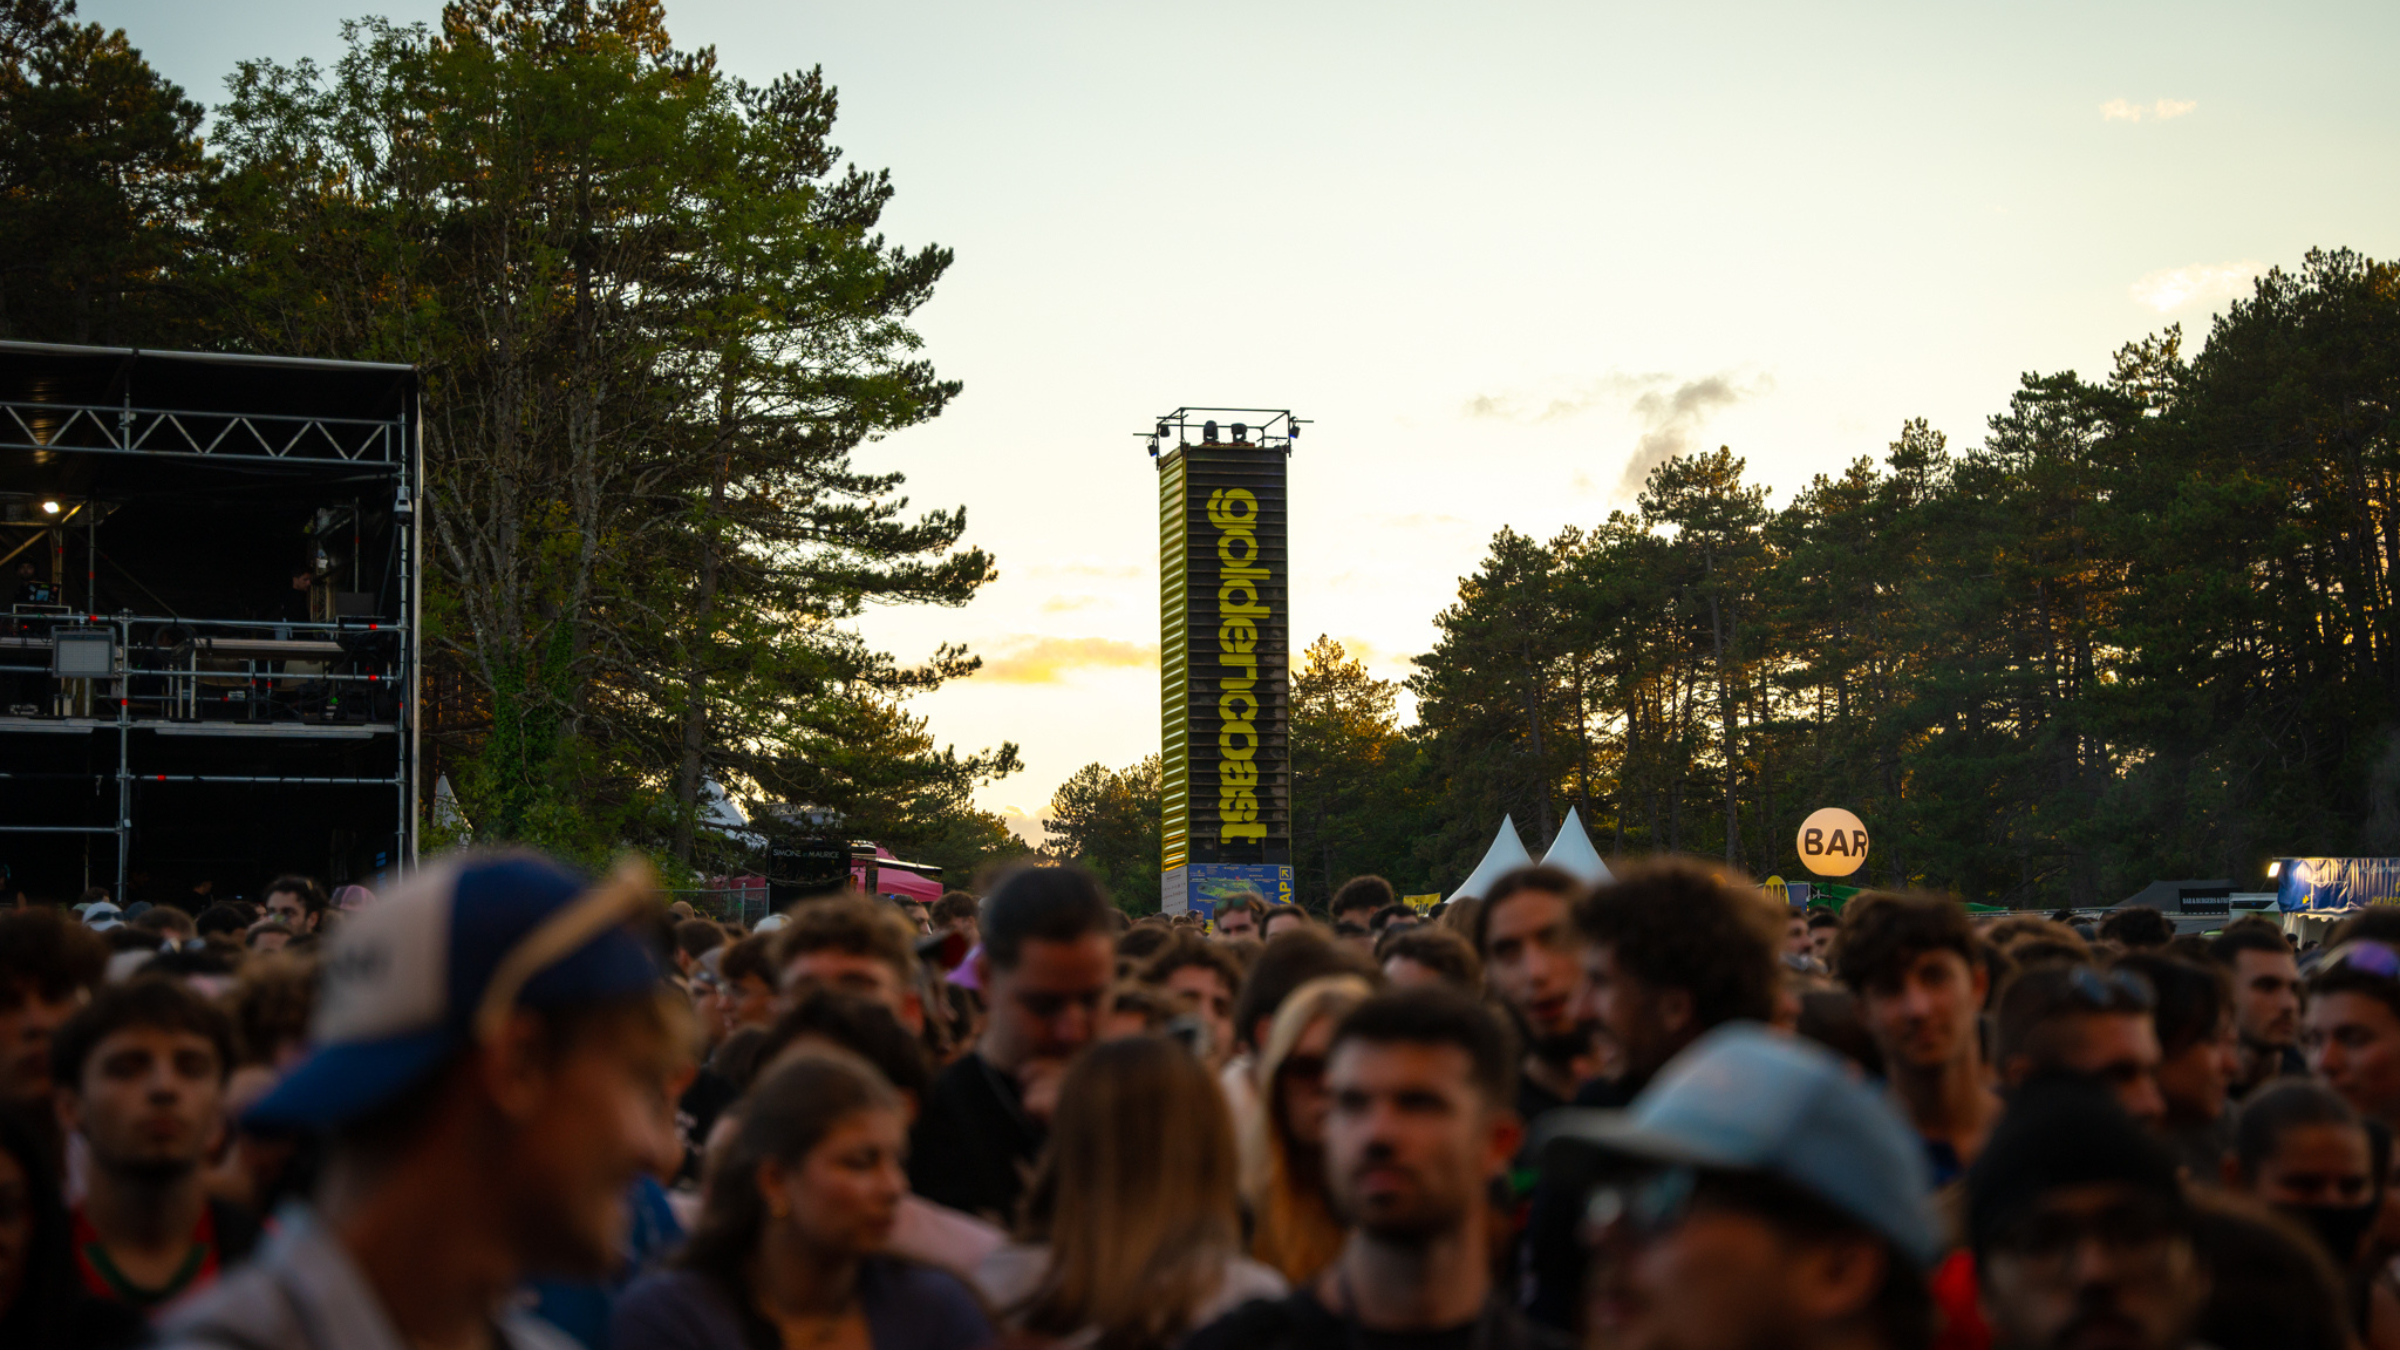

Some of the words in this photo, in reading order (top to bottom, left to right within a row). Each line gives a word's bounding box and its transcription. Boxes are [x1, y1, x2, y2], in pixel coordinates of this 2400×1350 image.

[1206, 487, 1271, 844] goldencoast
[772, 849, 801, 857] SIMONE
[808, 851, 840, 859] MAURICE
[1804, 828, 1867, 857] BAR
[1279, 881, 1291, 906] AP
